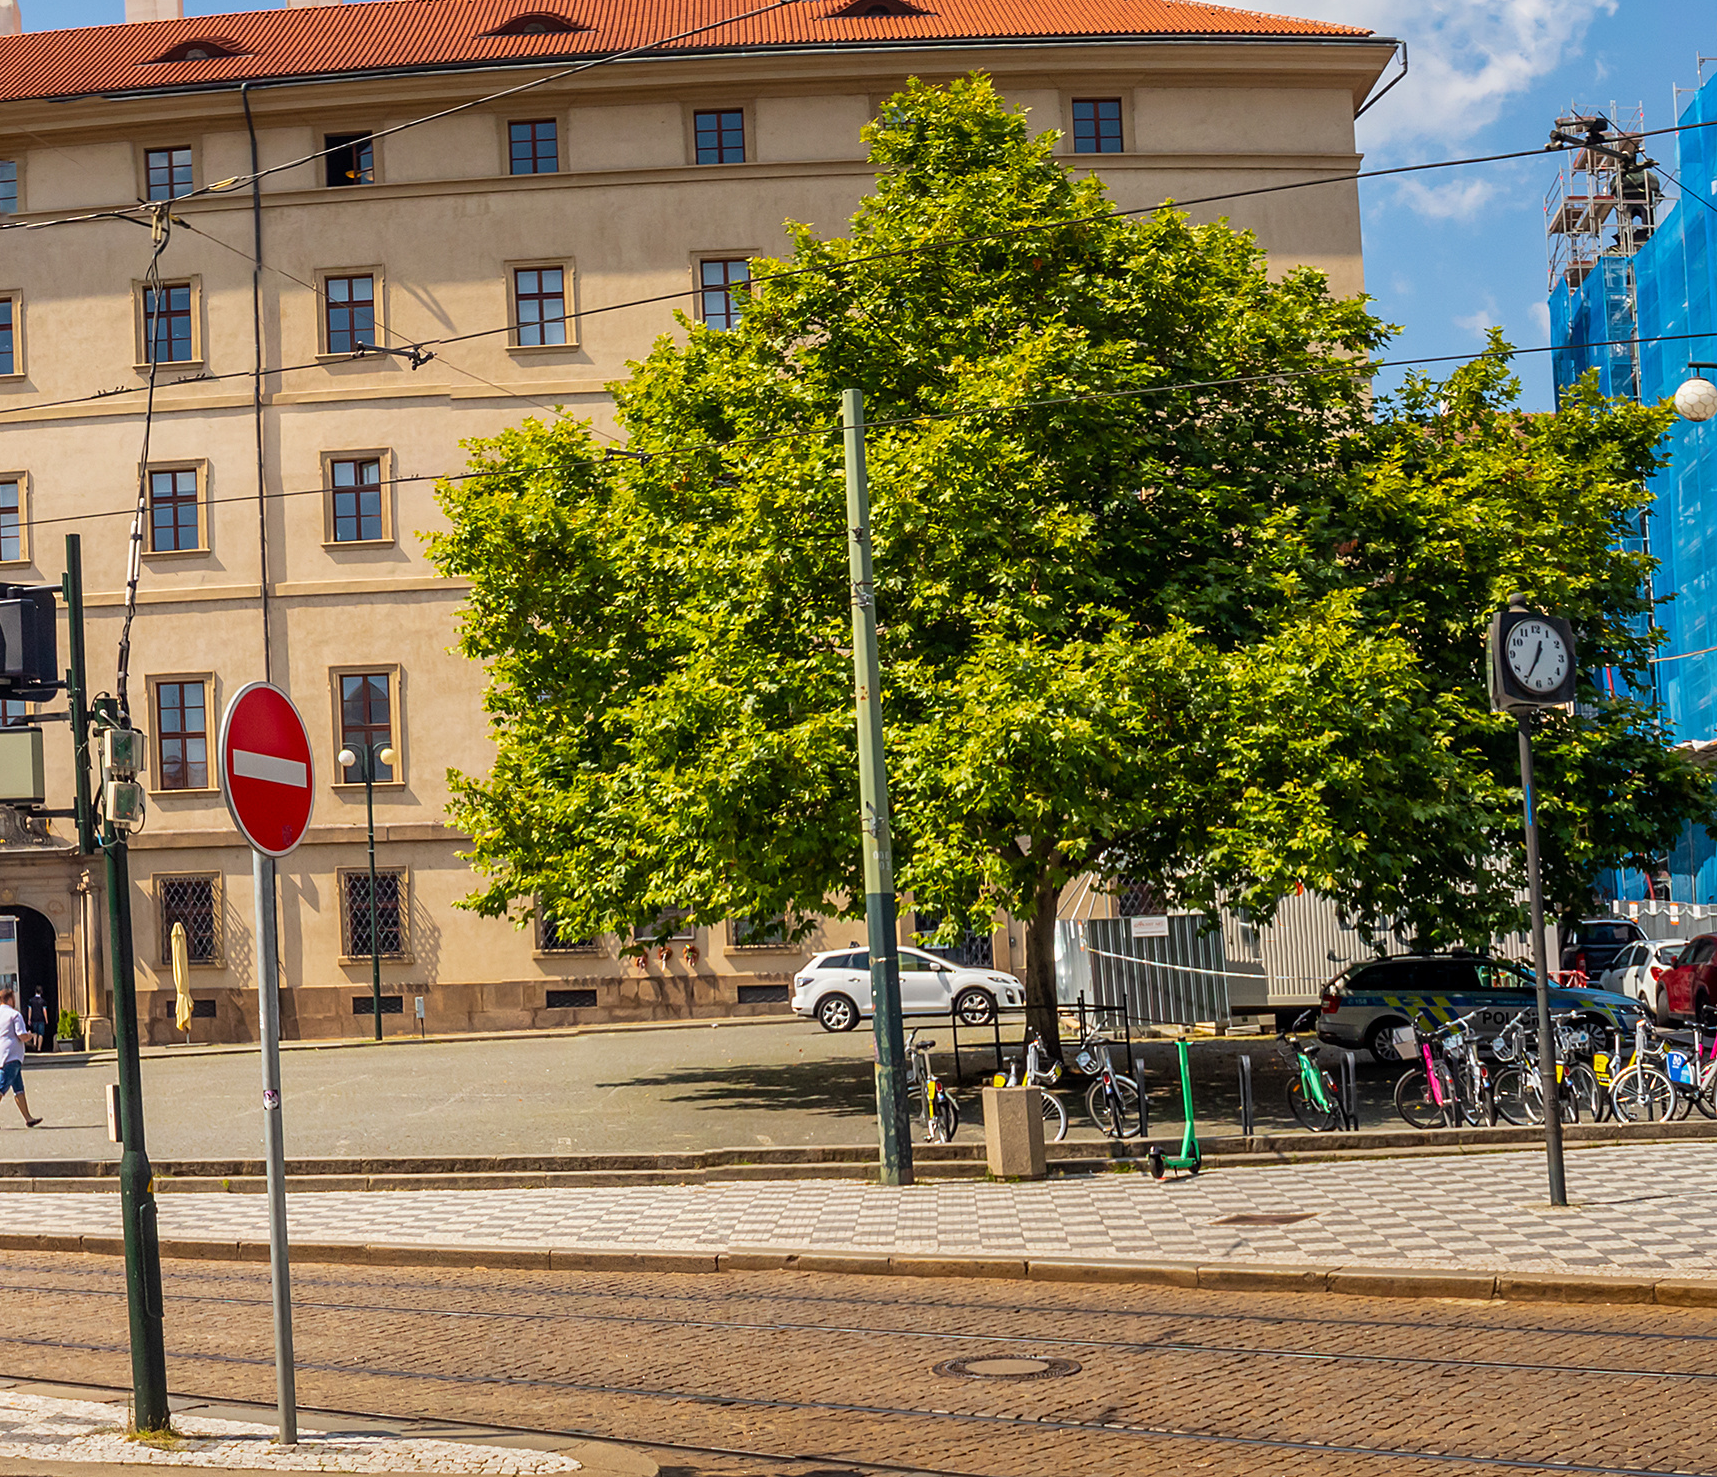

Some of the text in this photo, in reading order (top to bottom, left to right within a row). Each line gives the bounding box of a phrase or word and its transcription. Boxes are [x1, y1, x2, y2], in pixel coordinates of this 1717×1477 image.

[1520, 628, 1529, 638] 11
[1531, 625, 1541, 634] 12
[1545, 630, 1549, 638] 1
[1513, 638, 1523, 647] 10
[1554, 640, 1560, 649] 2
[1509, 650, 1516, 659] 9
[1558, 654, 1564, 663] 3
[1514, 664, 1521, 673] 8
[1555, 667, 1560, 676] 4
[1524, 675, 1529, 684] 7
[1535, 680, 1542, 688] 6
[1548, 677, 1553, 686] 5
